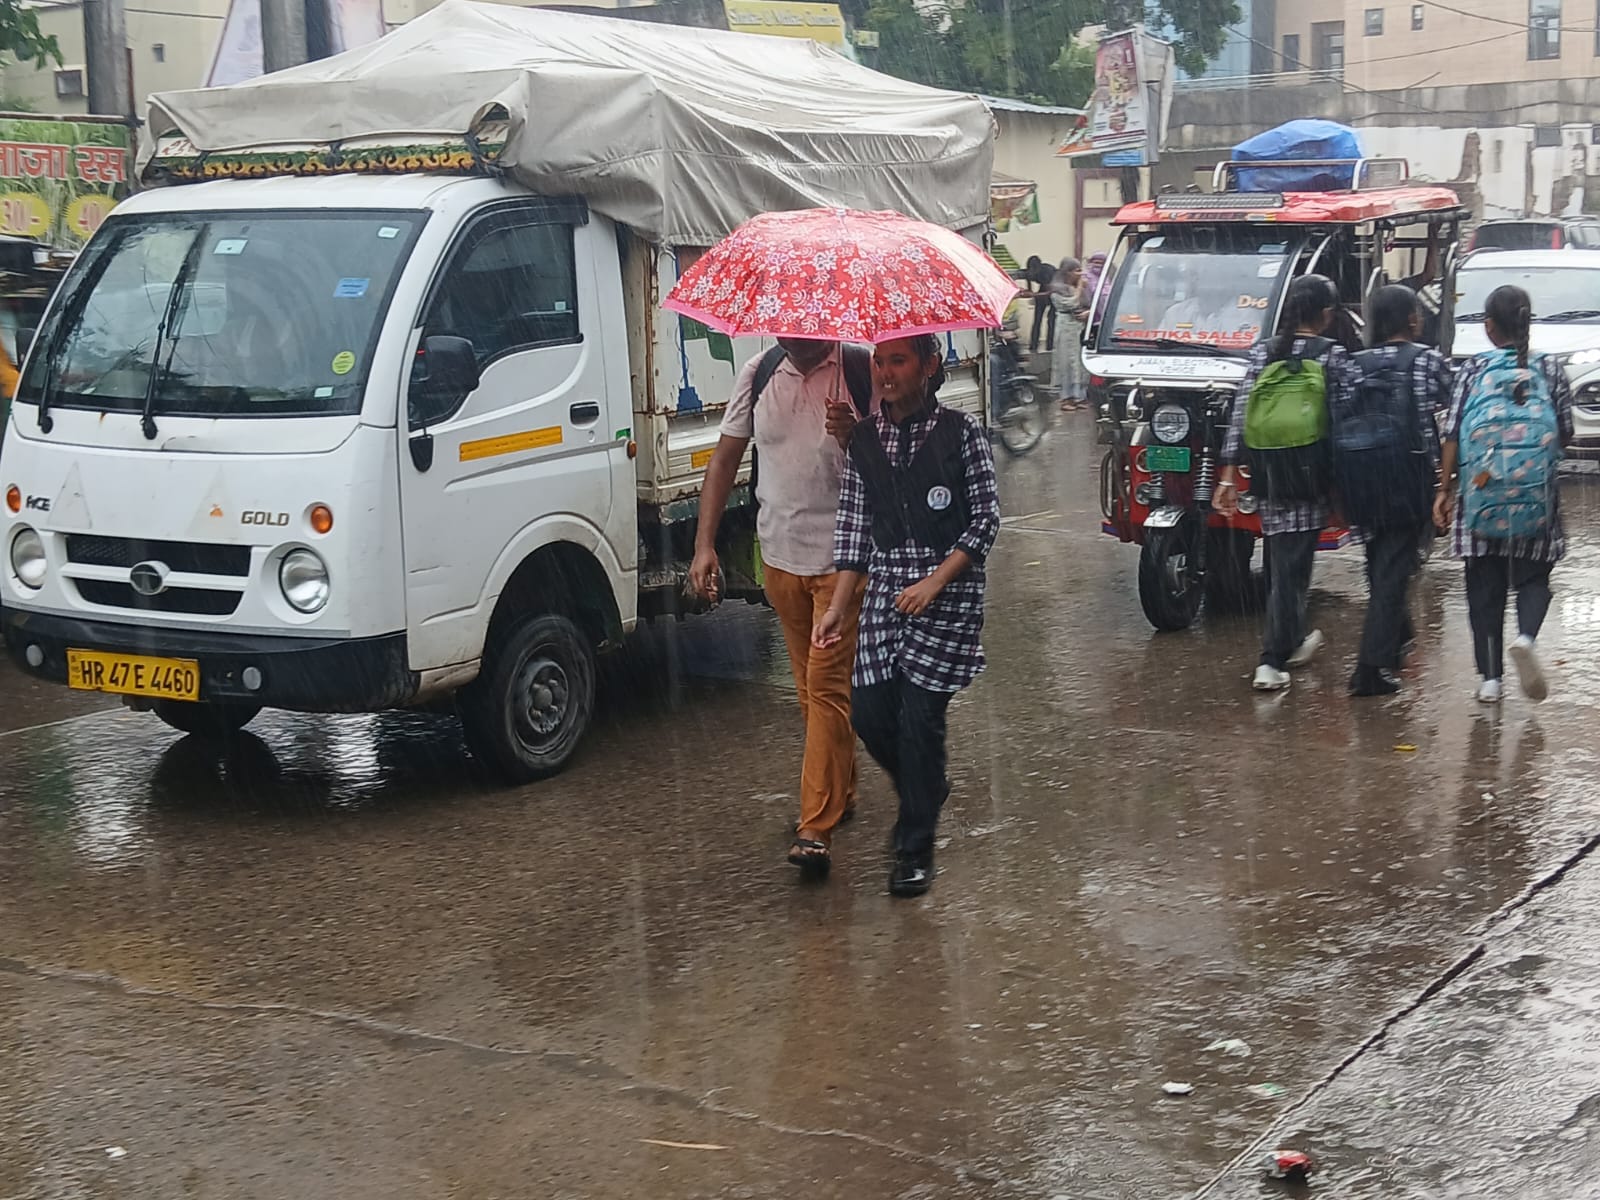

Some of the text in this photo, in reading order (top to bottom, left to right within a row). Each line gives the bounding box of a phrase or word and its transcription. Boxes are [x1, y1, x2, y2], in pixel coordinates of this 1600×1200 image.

[75, 145, 127, 183] रस
[1119, 329, 1254, 340] KRITIKA SALES
[25, 495, 51, 511] ACE
[241, 510, 290, 526] GOLD
[80, 660, 104, 686] HR
[109, 662, 130, 687] 47
[134, 664, 145, 689] E
[151, 666, 194, 694] 4460
